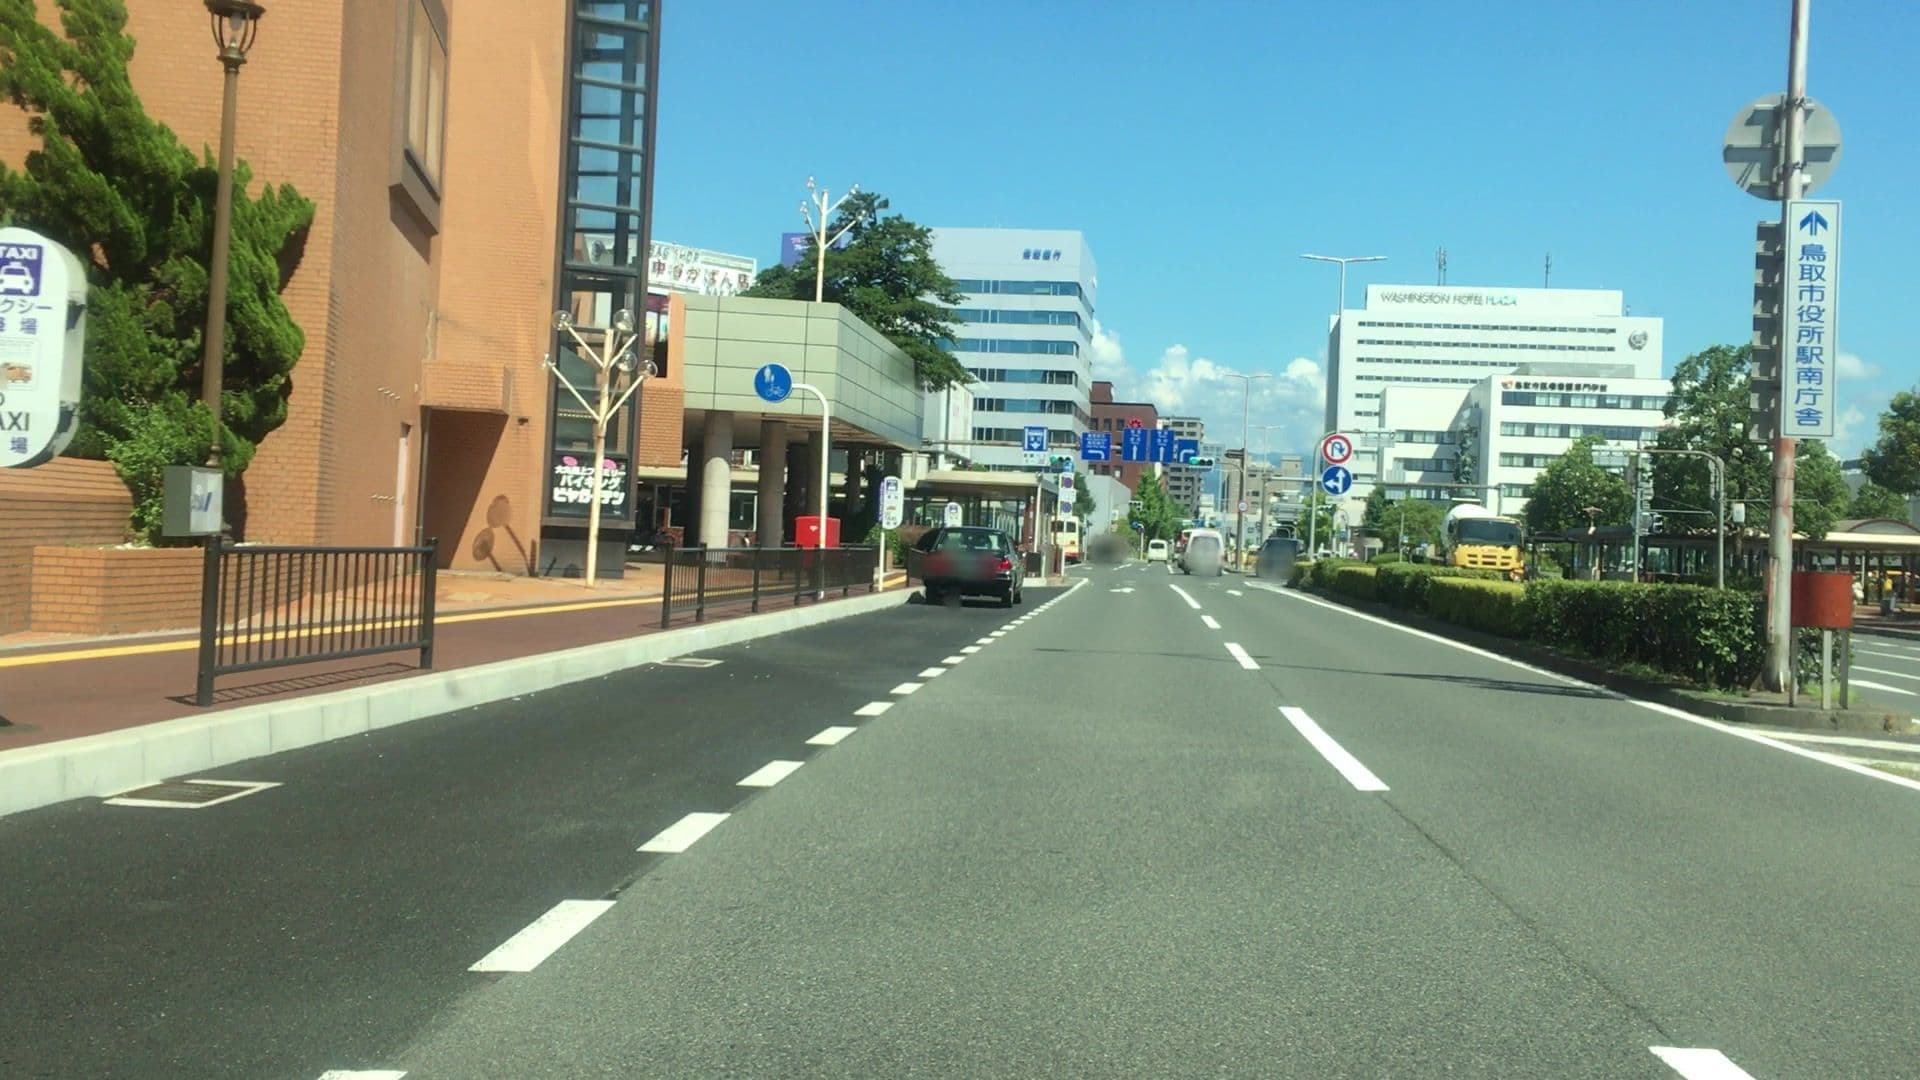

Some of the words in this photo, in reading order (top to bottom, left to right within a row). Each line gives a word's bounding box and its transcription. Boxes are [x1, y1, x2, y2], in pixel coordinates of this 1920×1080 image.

[1380, 291, 1450, 305] WASHINGTON
[1453, 293, 1483, 305] HOTEL
[1795, 243, 1827, 427] 鳥取市役所駅南庁舎
